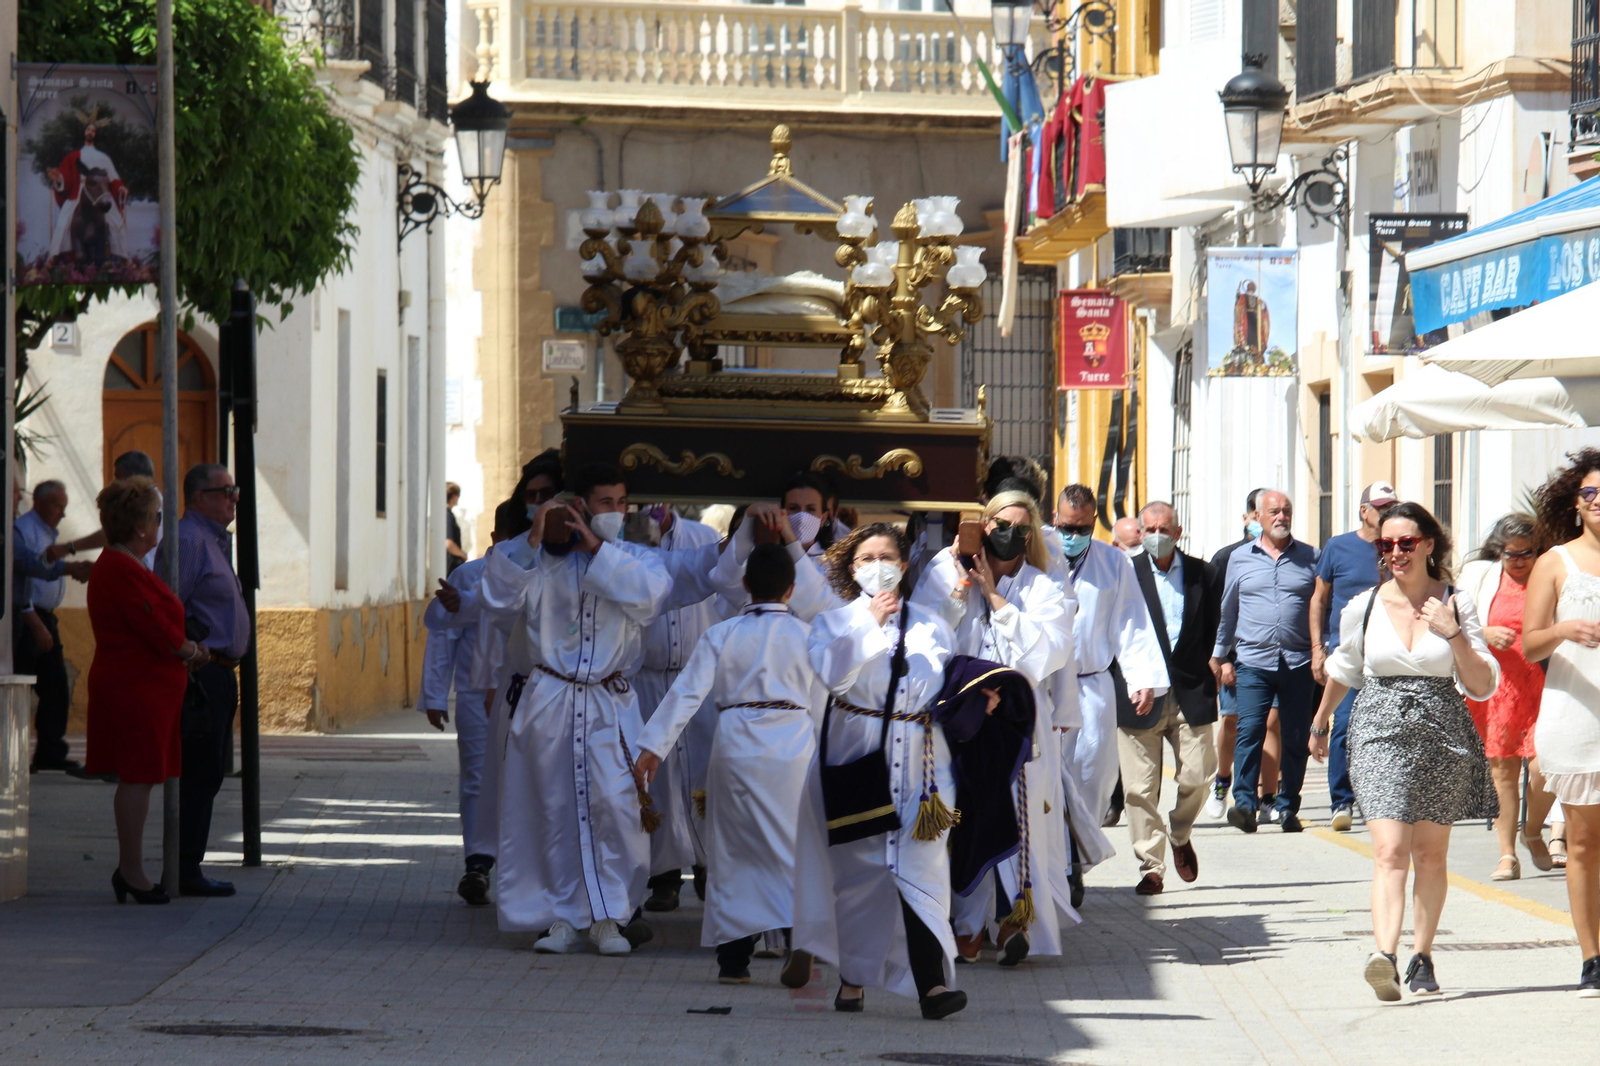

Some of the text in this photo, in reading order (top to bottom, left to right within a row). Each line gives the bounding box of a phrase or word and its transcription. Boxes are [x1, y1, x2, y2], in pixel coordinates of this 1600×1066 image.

[28, 76, 113, 88] Semana Santa
[1375, 218, 1431, 227] Semana Santa
[1375, 227, 1396, 235] Turre
[1481, 255, 1521, 306] BAR
[1547, 239, 1584, 291] LOS
[1070, 296, 1115, 308] Semana
[1076, 306, 1110, 318] Santa
[57, 325, 68, 342] 2
[1079, 370, 1110, 382] Turre
